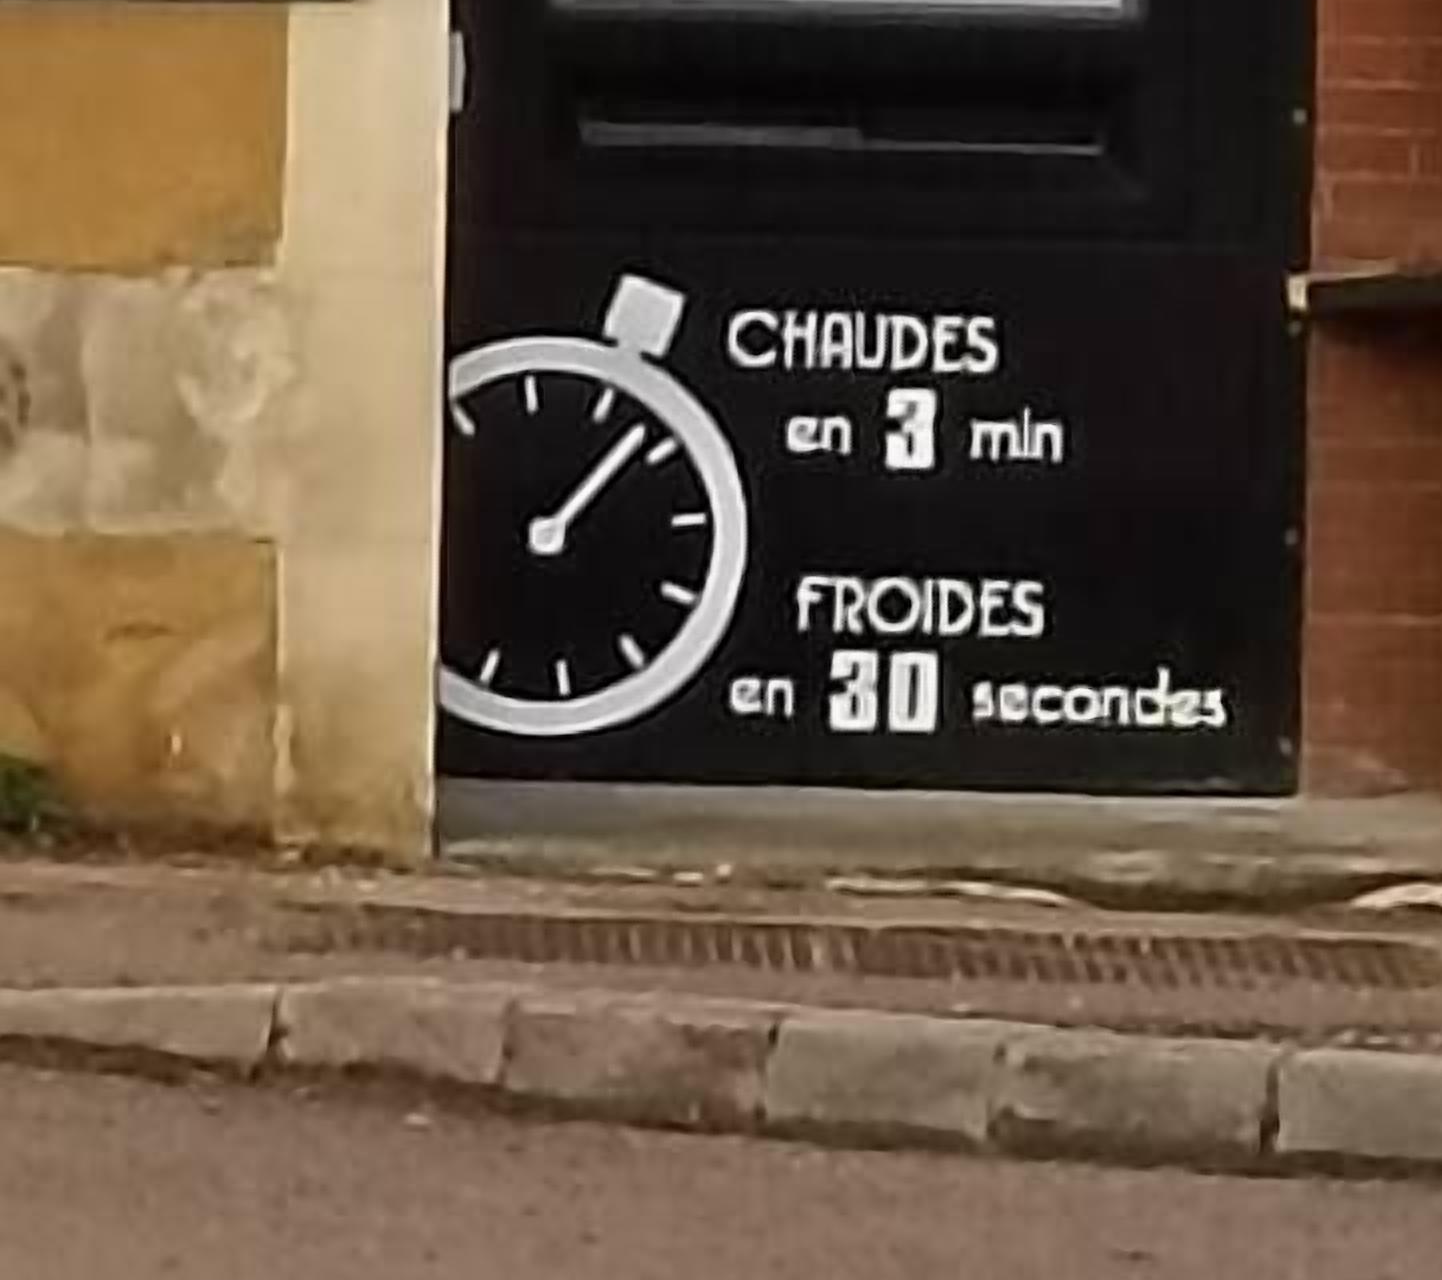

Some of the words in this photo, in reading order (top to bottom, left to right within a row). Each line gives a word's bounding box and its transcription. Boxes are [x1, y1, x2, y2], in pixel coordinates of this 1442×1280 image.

[727, 309, 999, 374] CHAUDES
[785, 415, 852, 455] en
[884, 387, 937, 471] 3
[969, 407, 1064, 463] min
[796, 575, 1046, 637] FROIDES
[729, 677, 794, 718] en
[828, 649, 939, 733] 30
[972, 667, 1227, 728] secondes
